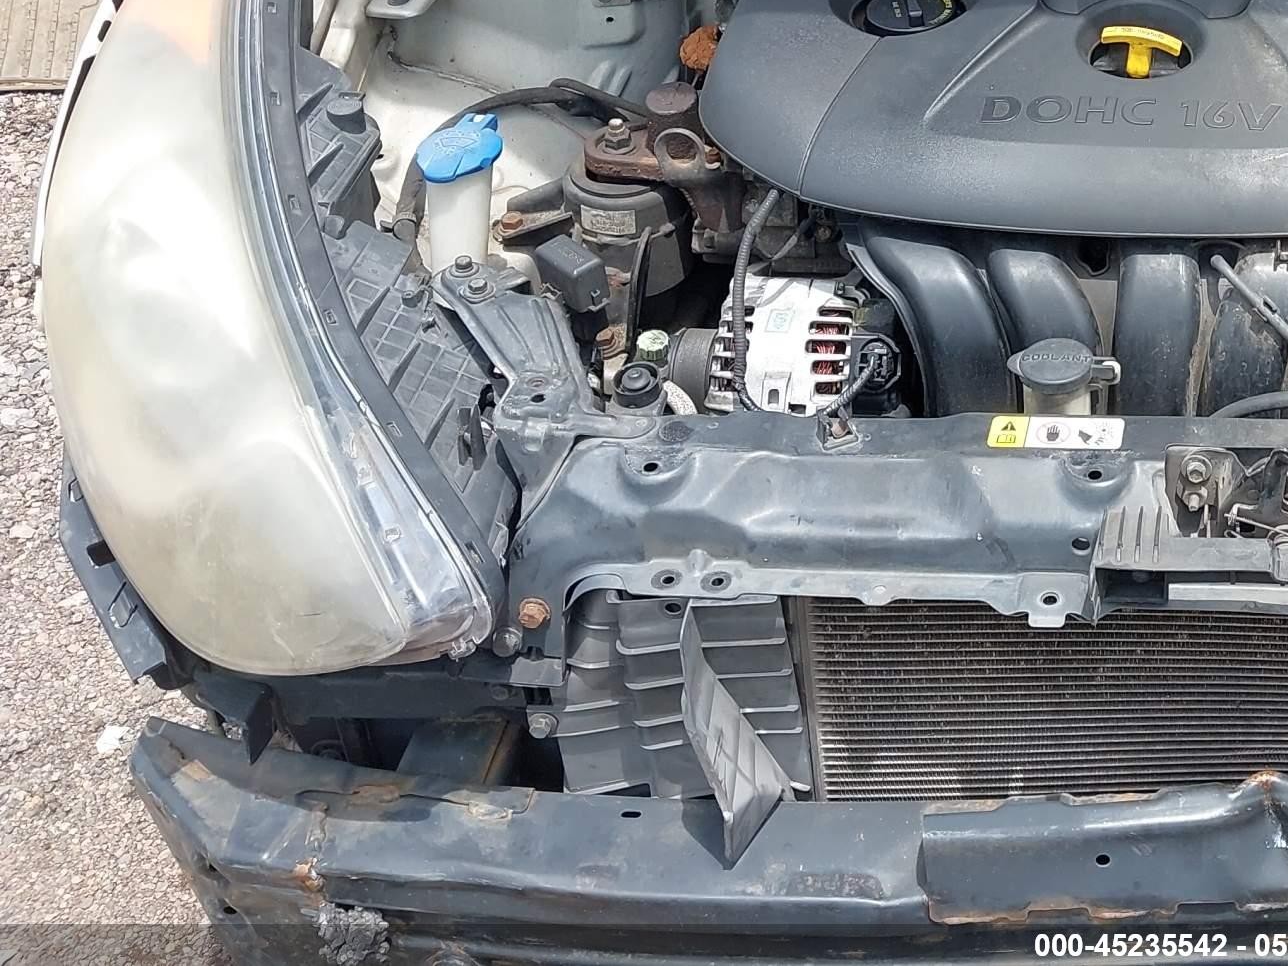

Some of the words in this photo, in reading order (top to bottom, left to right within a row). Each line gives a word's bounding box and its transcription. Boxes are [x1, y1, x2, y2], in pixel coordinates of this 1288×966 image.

[980, 95, 1157, 126] DOHC
[1180, 98, 1283, 131] 16V
[1021, 353, 1092, 363] COOLANT
